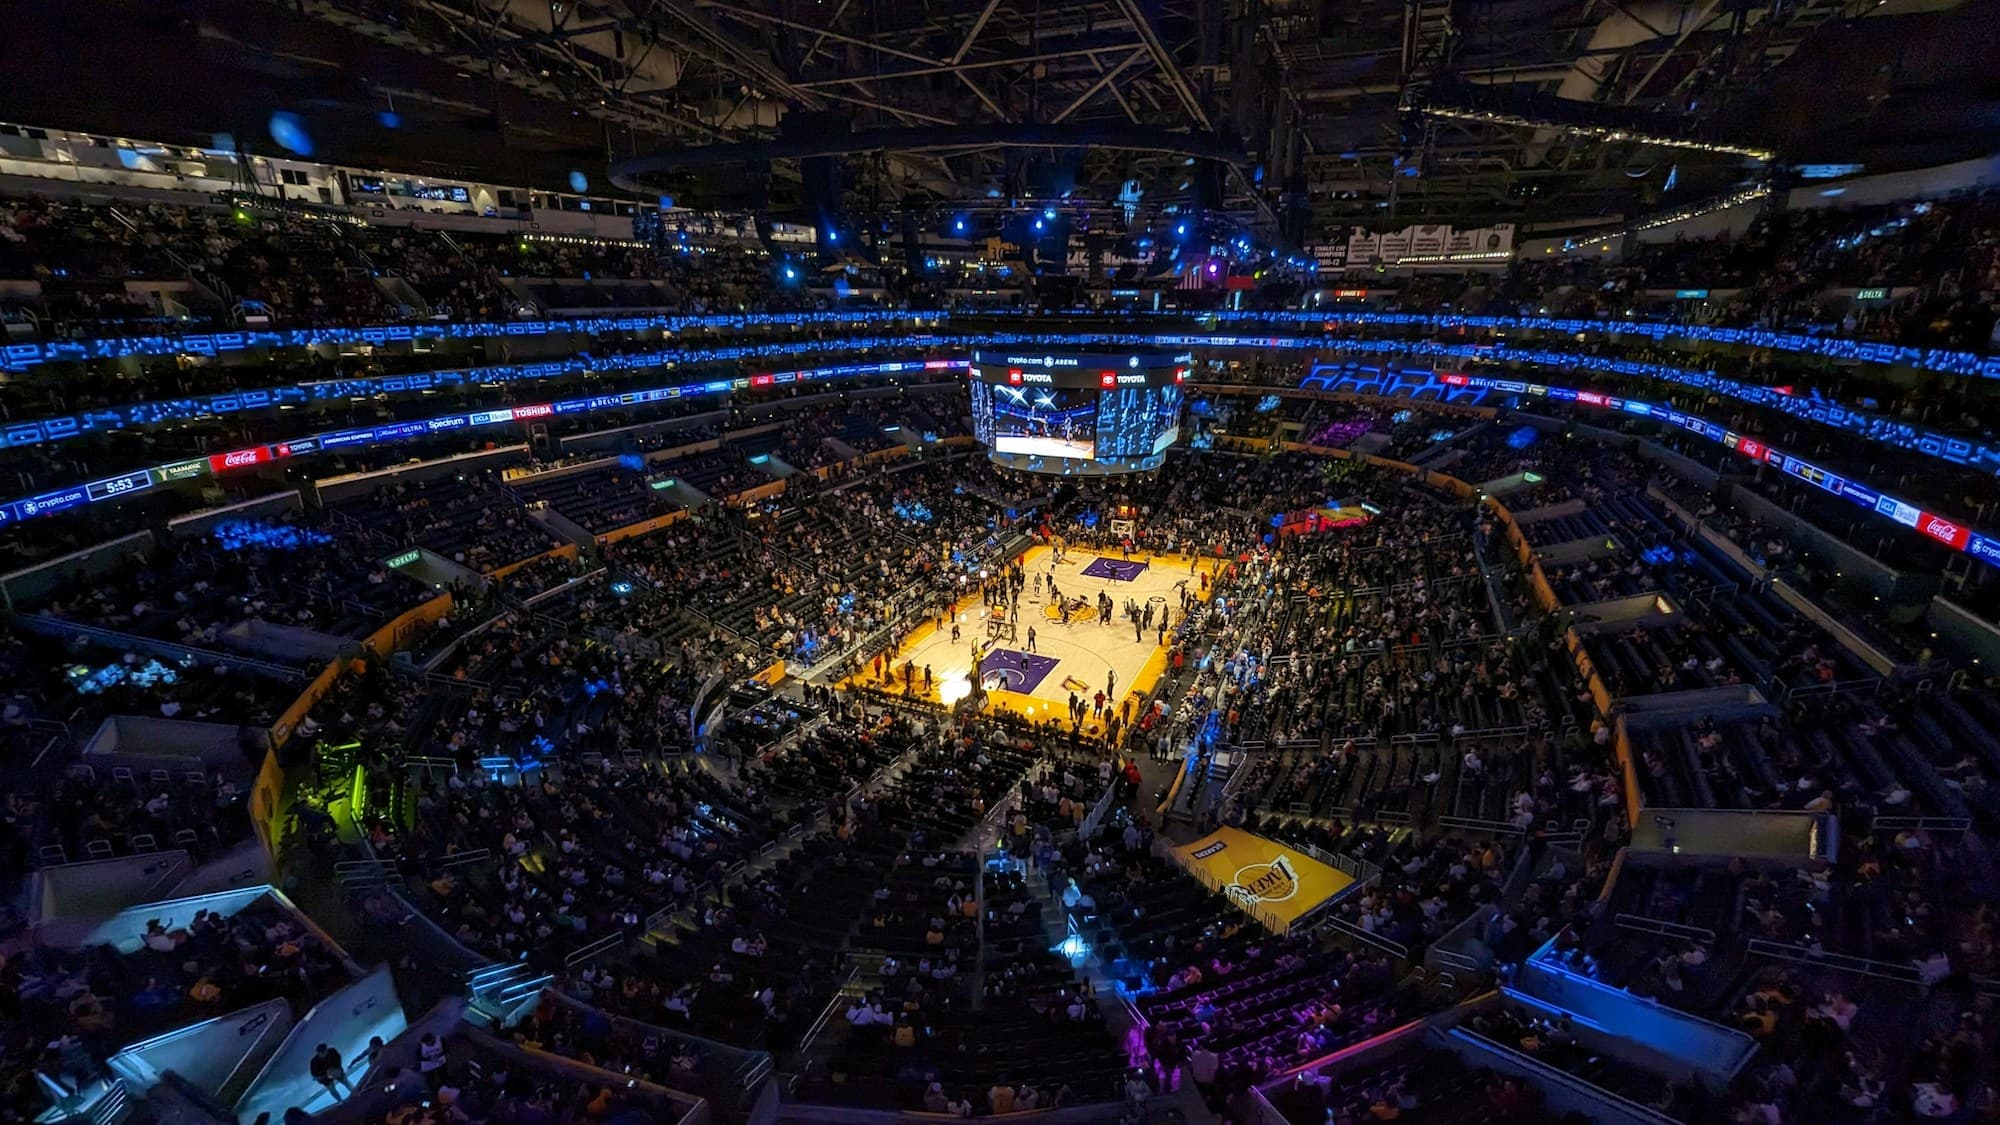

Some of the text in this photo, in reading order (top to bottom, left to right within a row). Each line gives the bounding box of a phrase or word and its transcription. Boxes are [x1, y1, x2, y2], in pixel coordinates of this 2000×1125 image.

[1863, 290, 1882, 299] DELTA
[1007, 356, 1078, 366] crypto.com ARENA
[1023, 373, 1052, 383] TOYOTA
[1117, 375, 1145, 383] TOYOTA
[597, 397, 620, 406] DELTA
[514, 405, 552, 418] TOSHIBA
[428, 417, 465, 431] Spectrum
[474, 414, 489, 423] UCLA
[402, 425, 423, 434] ULTRA
[324, 432, 374, 444] AMERICAN EXPRESS
[289, 442, 313, 452] TOYOTA
[225, 450, 256, 467] Coca-Cola
[106, 478, 133, 494] 5:53
[38, 492, 82, 508] crypto.com
[1880, 500, 1917, 522] UCLA Health
[1927, 520, 1958, 542] Coca-Cola
[394, 549, 419, 566] DELTA
